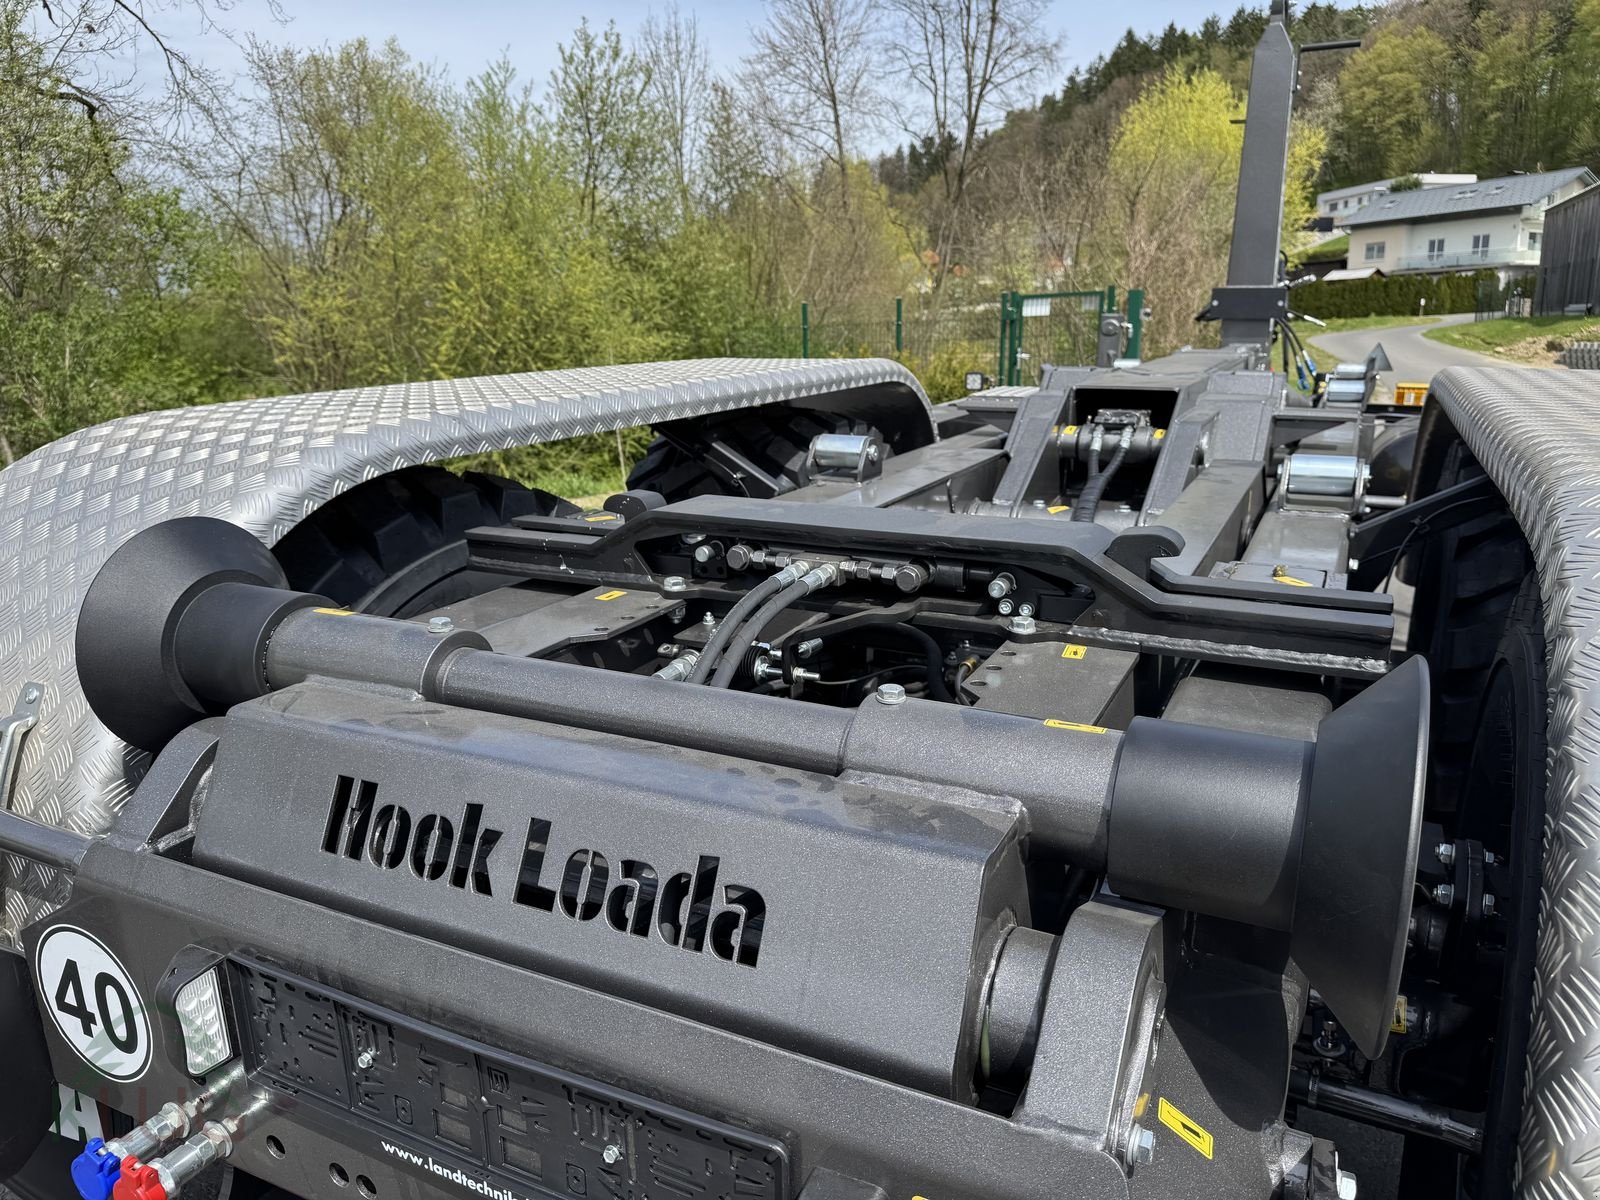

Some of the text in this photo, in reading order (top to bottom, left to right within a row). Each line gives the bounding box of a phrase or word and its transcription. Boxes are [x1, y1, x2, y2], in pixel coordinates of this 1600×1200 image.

[320, 774, 767, 968] Hook Loada
[54, 958, 138, 1055] 40
[380, 1141, 528, 1200] www.landtechnik
